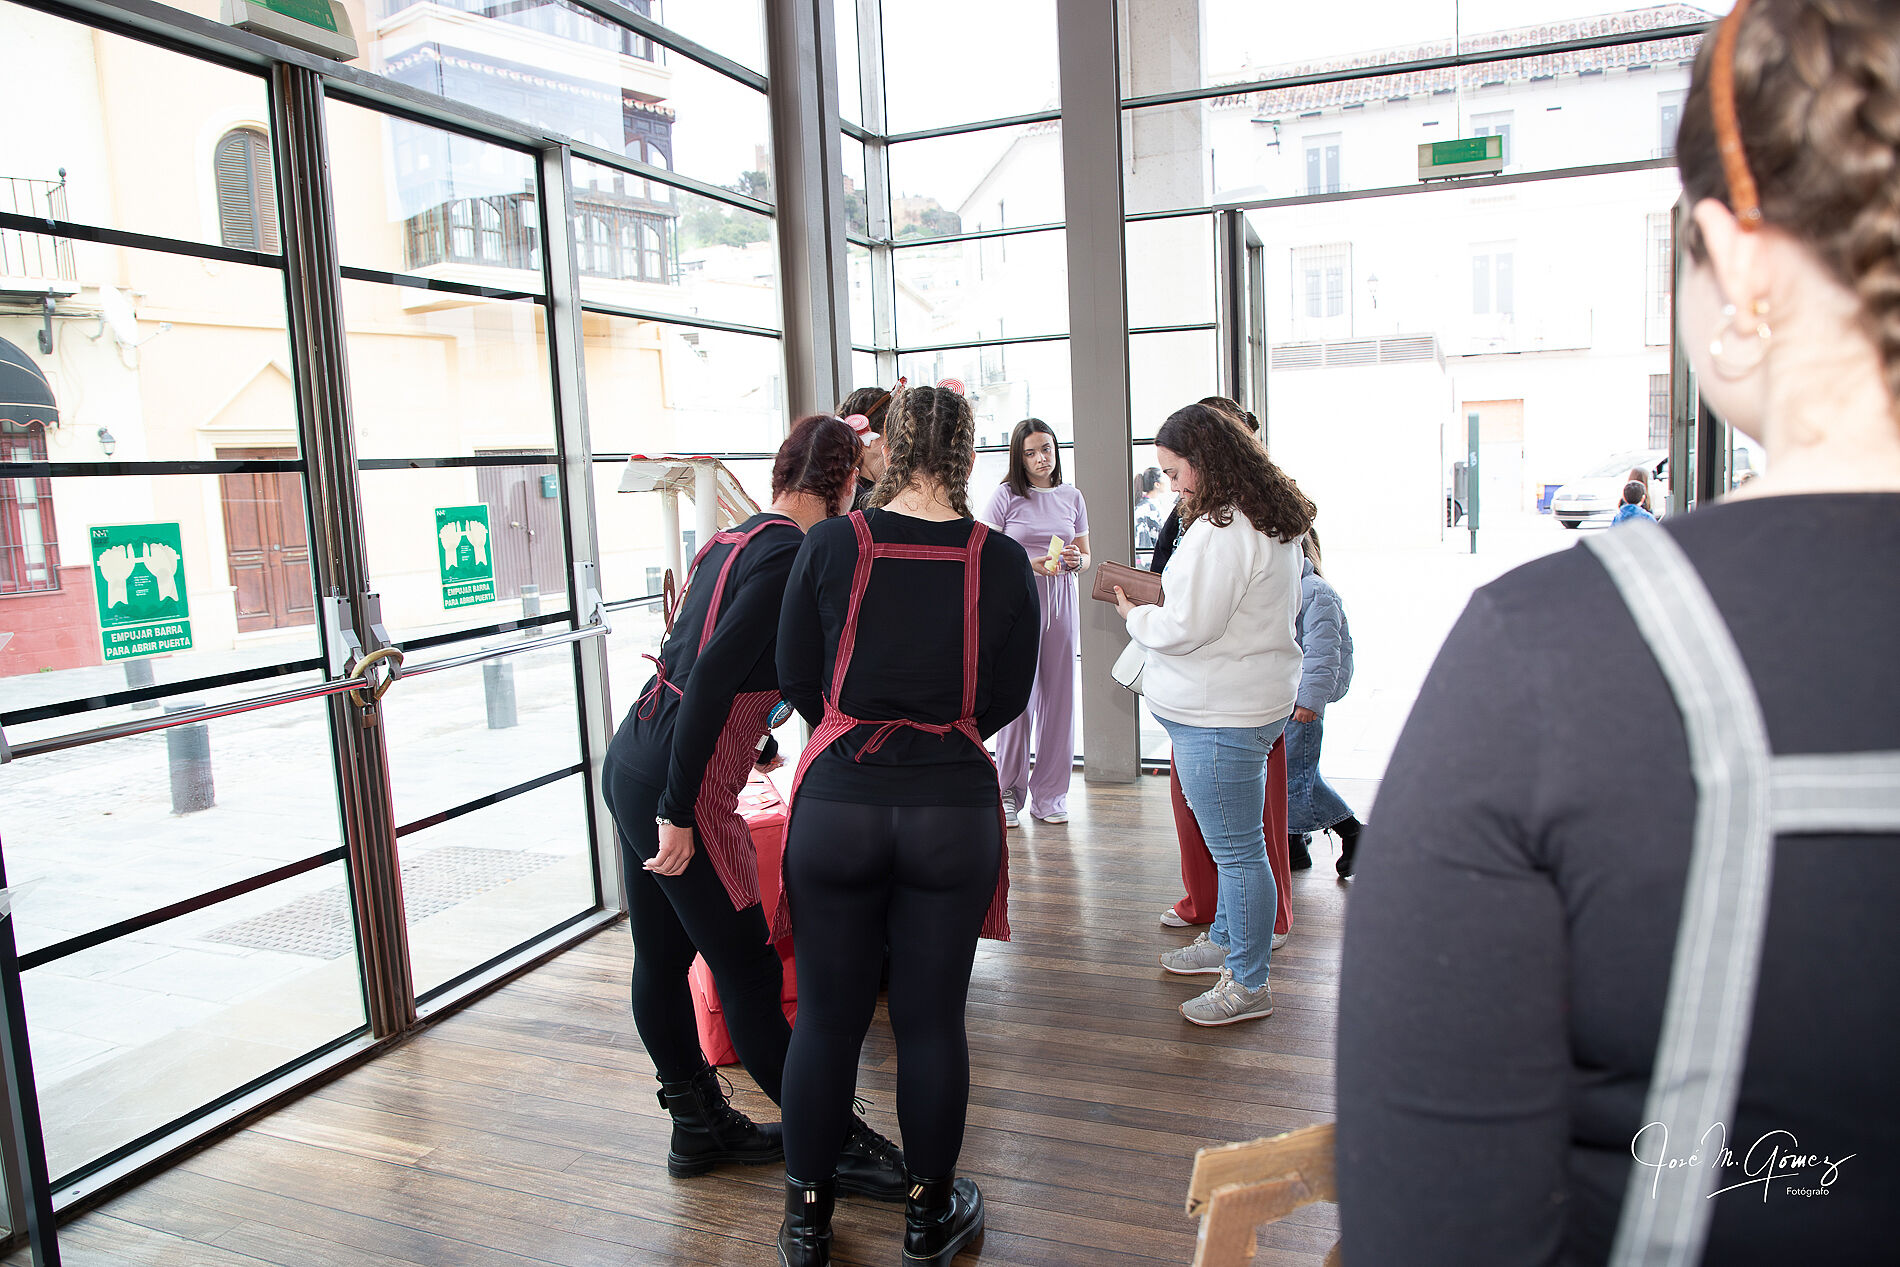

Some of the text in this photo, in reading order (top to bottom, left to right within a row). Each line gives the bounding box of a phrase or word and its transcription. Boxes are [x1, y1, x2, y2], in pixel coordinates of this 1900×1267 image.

[447, 583, 490, 597] EMPUJAR BARRA
[444, 598, 460, 607] PARA
[475, 593, 495, 603] PUERTA
[110, 624, 184, 643] EMPUJAR BARRA
[105, 636, 191, 657] PARA ABRIR PUERTA
